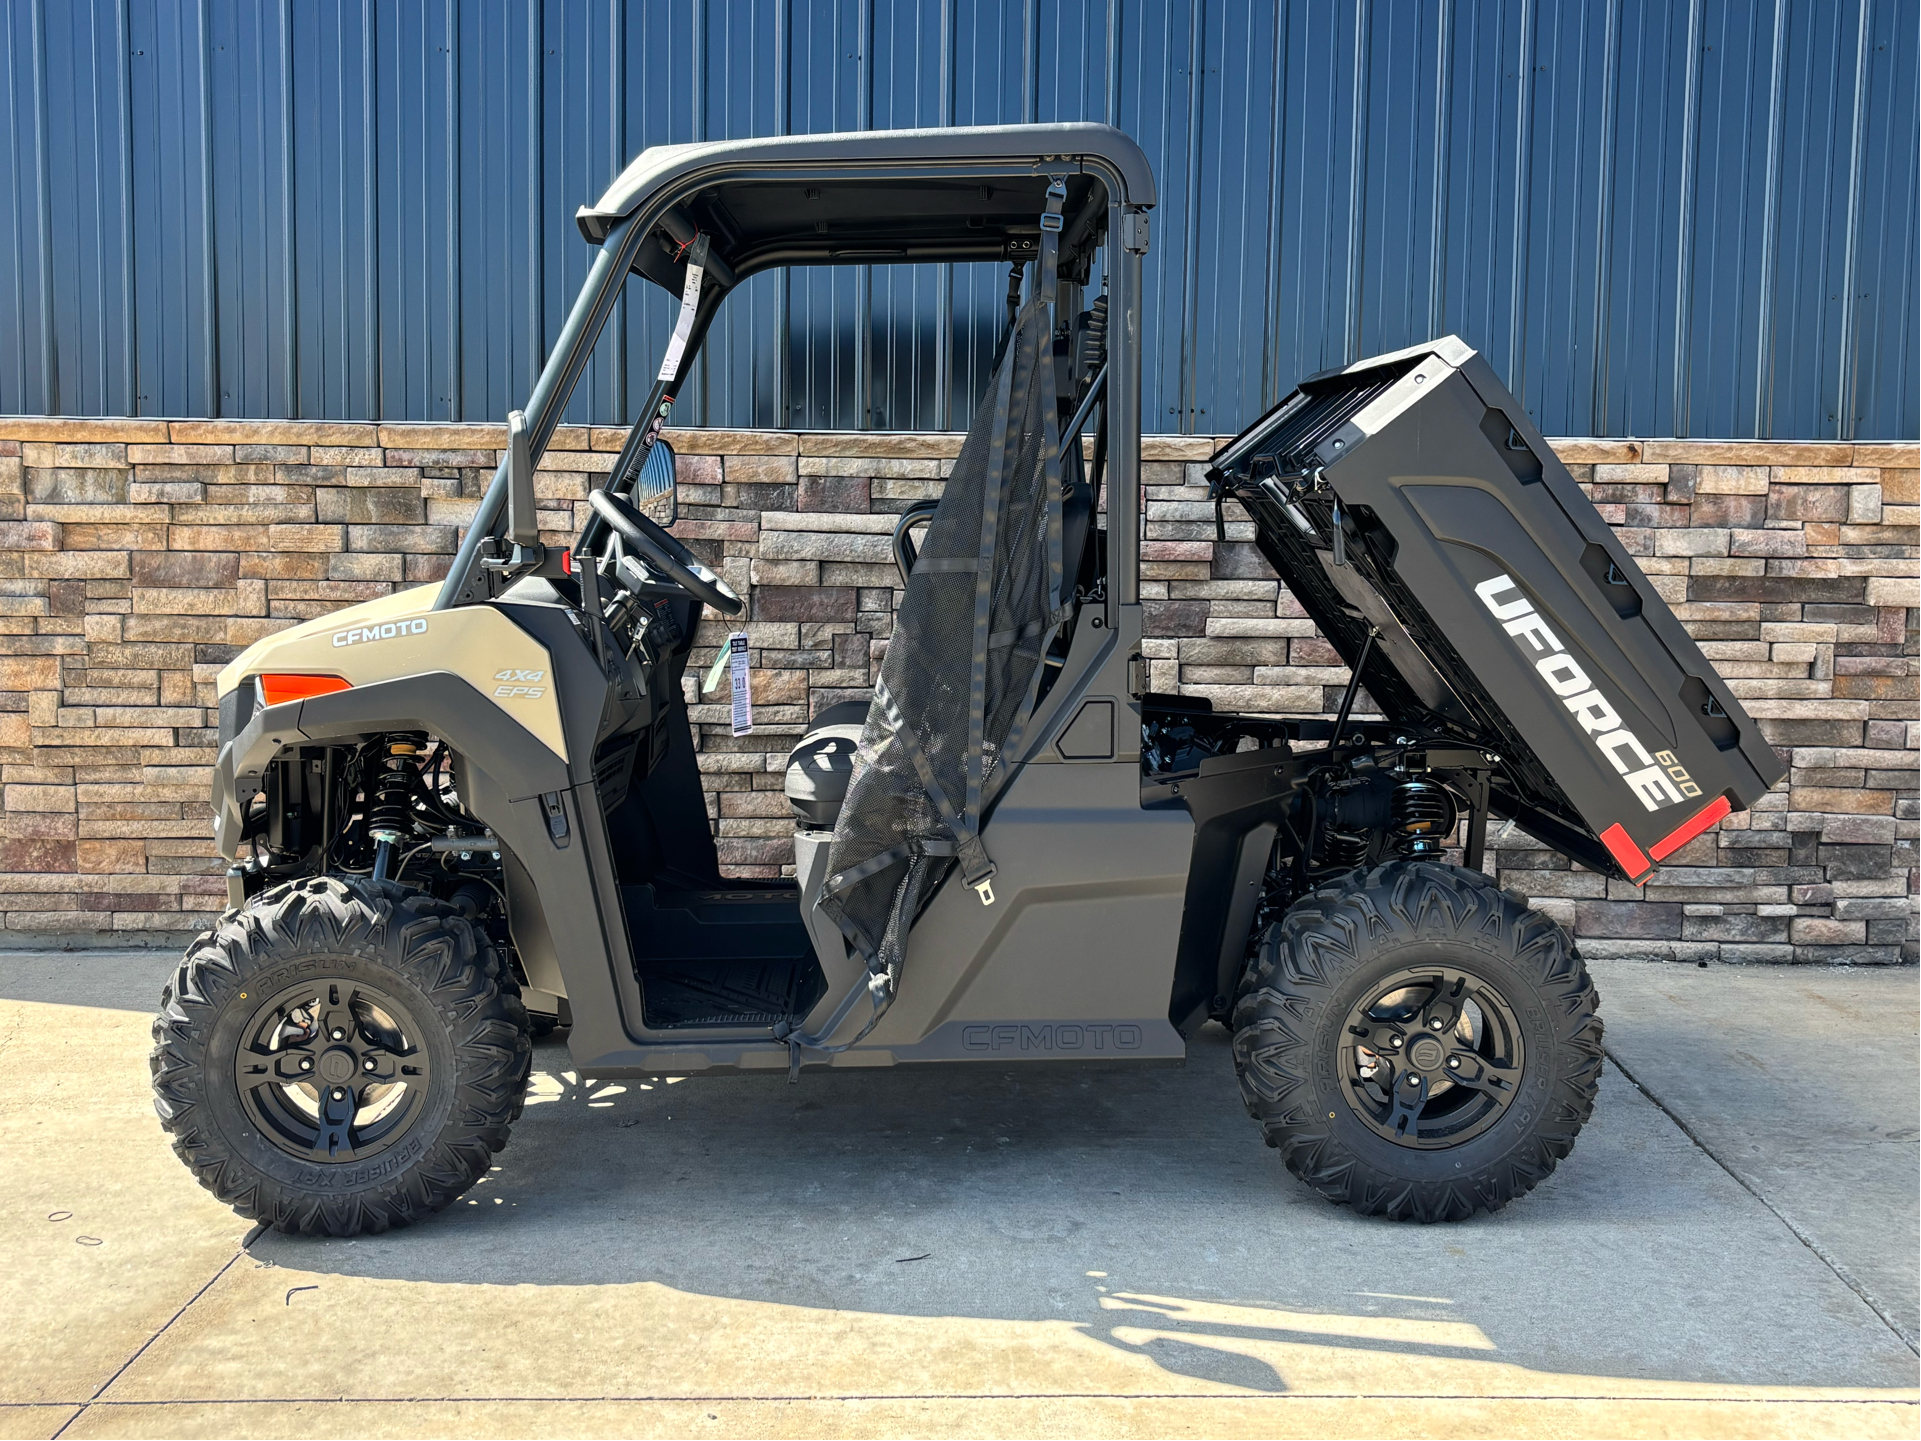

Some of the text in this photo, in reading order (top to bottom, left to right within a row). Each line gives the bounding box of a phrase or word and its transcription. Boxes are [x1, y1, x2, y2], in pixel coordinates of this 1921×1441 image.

[332, 618, 428, 648] CFMOTO
[493, 685, 545, 699] EPS
[494, 669, 546, 683] 4X4
[1474, 574, 1684, 812] UFORCE
[1655, 749, 1703, 798] 600
[255, 959, 357, 997] ARISUN
[962, 1024, 1142, 1050] CFMOTO
[1316, 995, 1346, 1095] ARISUN
[1525, 1006, 1551, 1091] BRUISER
